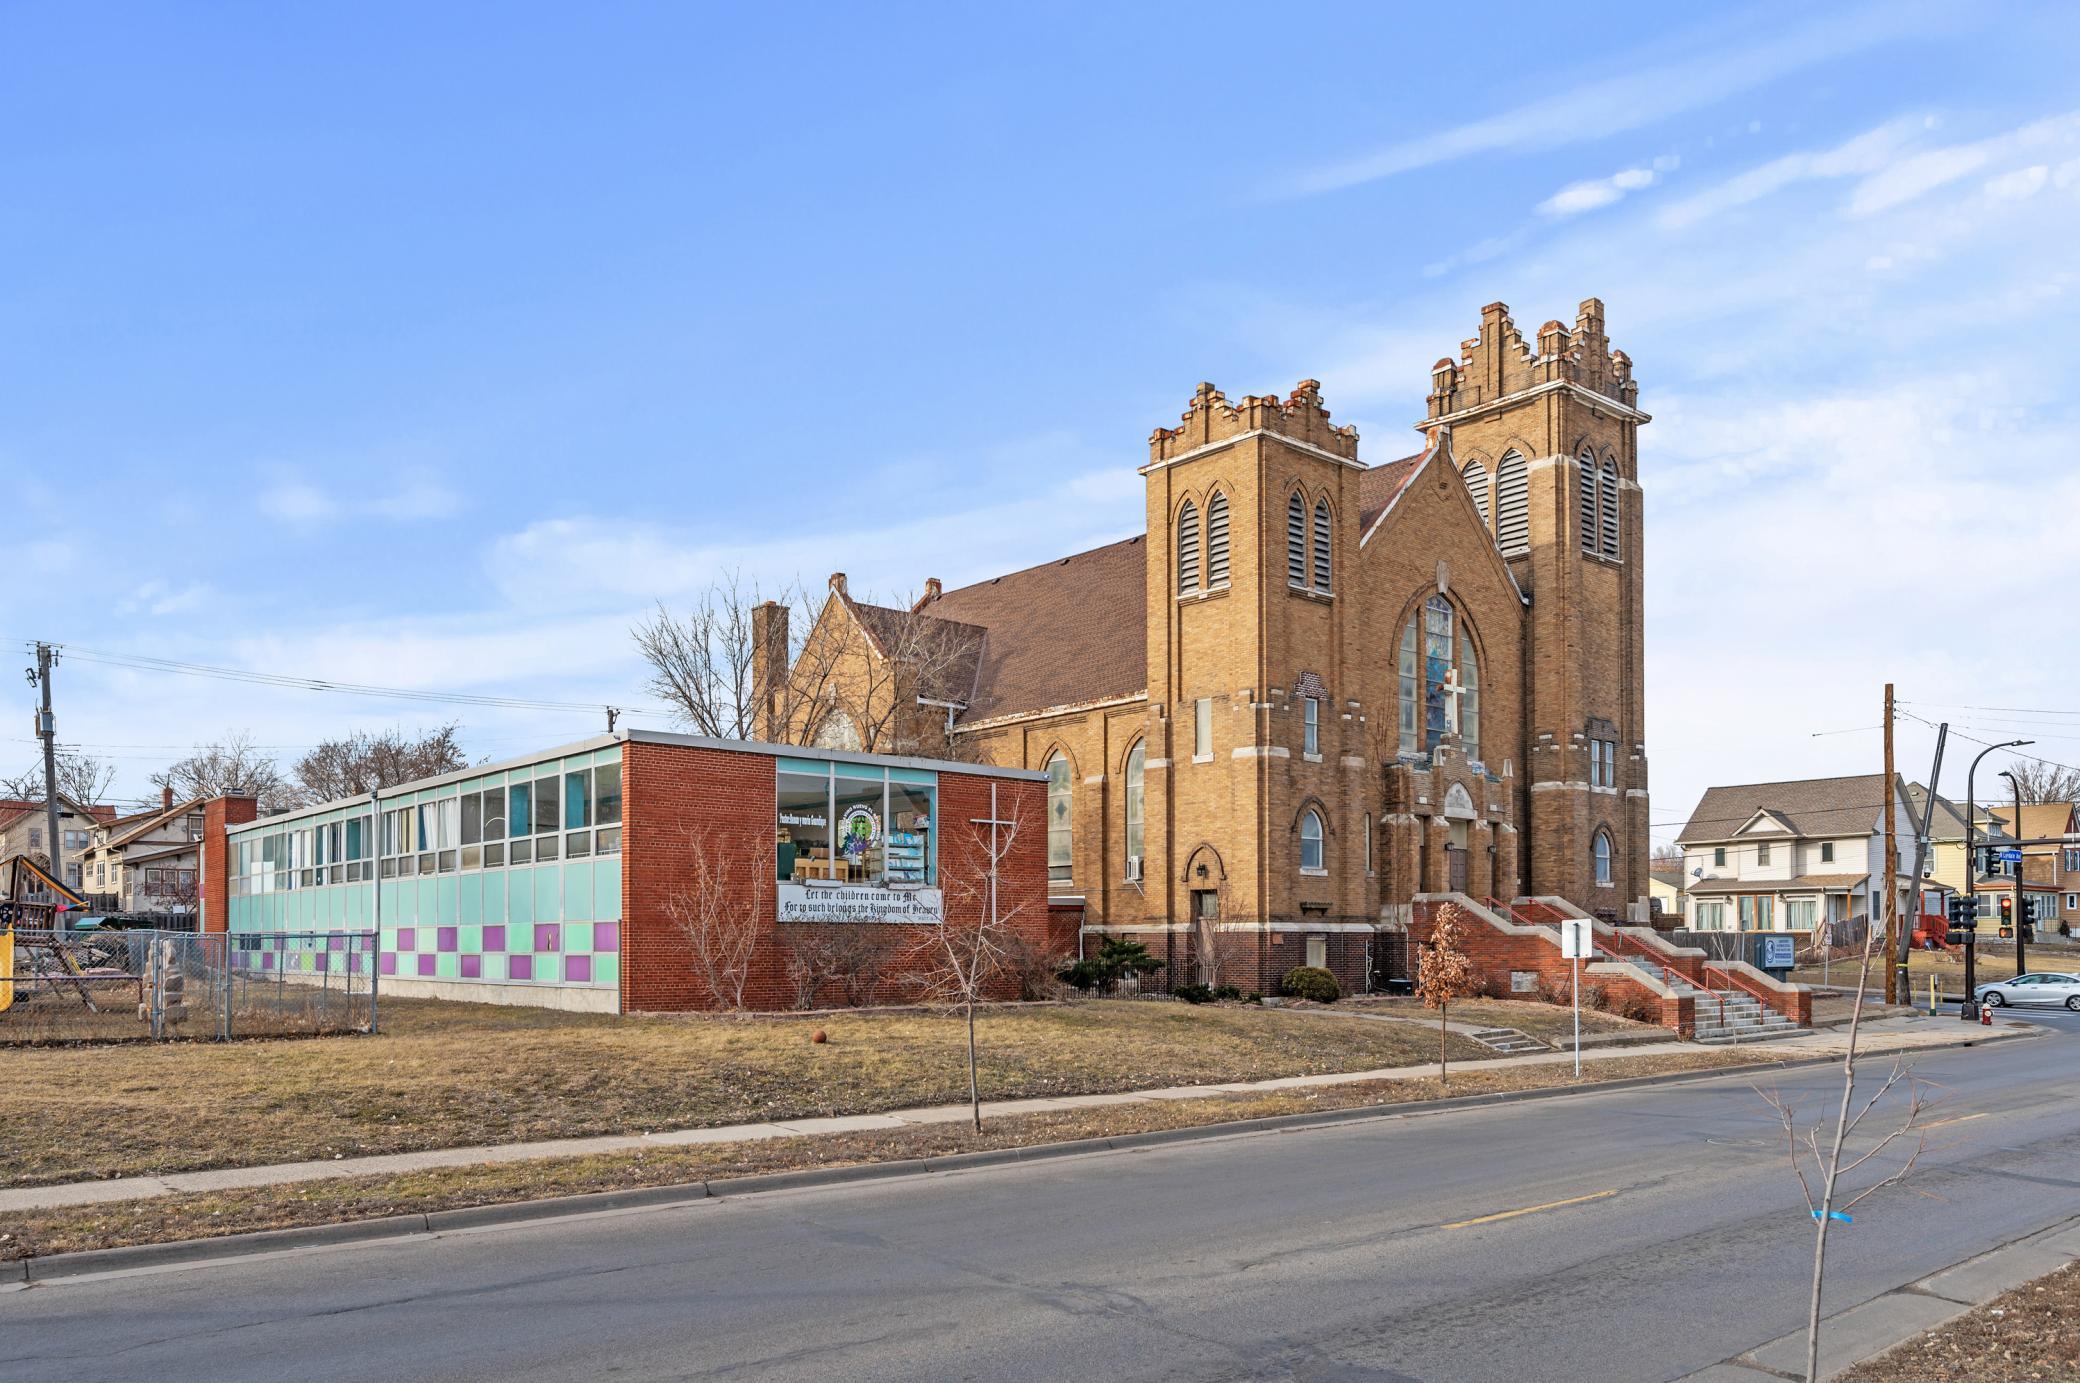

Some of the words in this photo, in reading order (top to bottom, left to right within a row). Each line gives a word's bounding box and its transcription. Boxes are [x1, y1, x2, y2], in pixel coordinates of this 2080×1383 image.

[805, 888, 818, 900] Let
[821, 889, 833, 900] the
[836, 890, 869, 902] children
[871, 893, 891, 901] come
[893, 892, 901, 902] to
[903, 891, 917, 903] Me
[784, 900, 798, 912] For
[808, 902, 826, 912] such
[827, 902, 857, 914] belongs
[858, 903, 869, 914] the
[870, 902, 902, 916] Kingdom
[903, 903, 910, 914] of
[912, 903, 938, 914] Heaven
